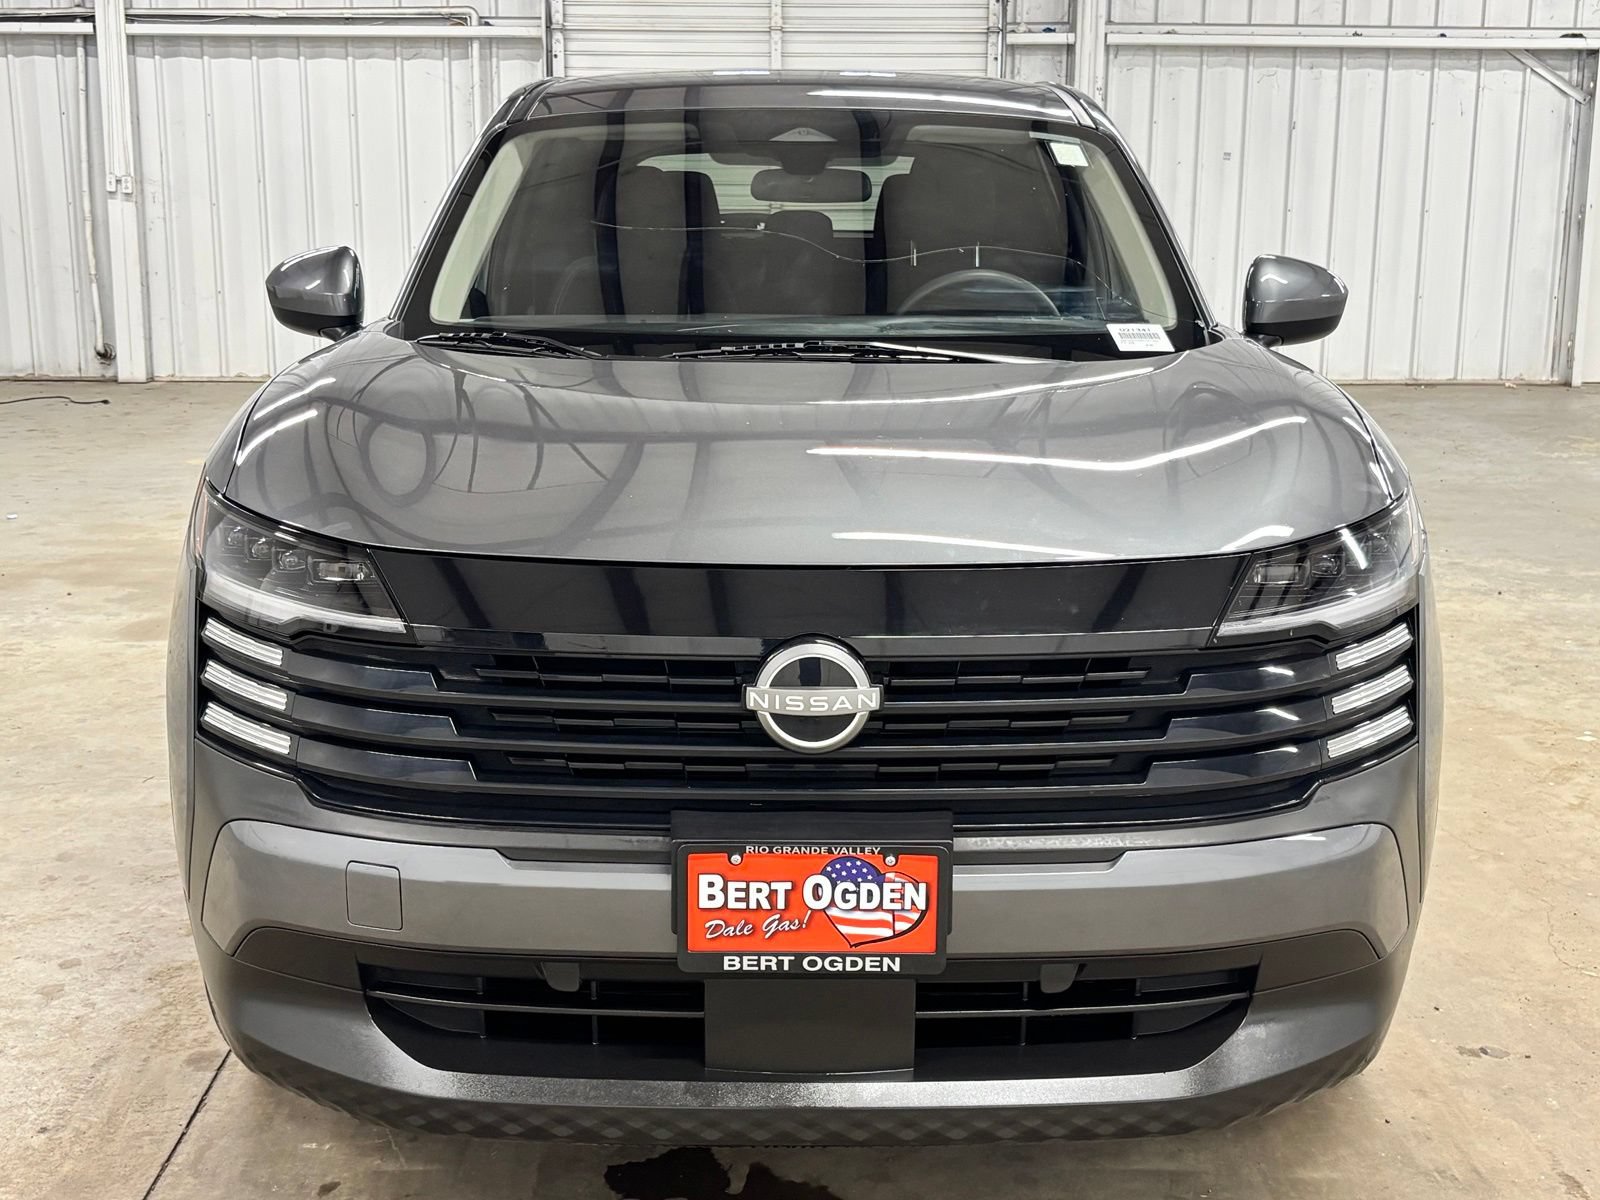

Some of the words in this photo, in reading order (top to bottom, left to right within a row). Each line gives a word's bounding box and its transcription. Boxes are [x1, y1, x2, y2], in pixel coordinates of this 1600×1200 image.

[749, 691, 877, 712] NISSAN
[745, 845, 770, 855] RIO
[775, 845, 829, 856] GRANDE
[831, 846, 881, 856] VALLEY
[697, 873, 793, 911] BERT
[802, 874, 928, 911] OGDEN
[704, 919, 753, 939] Dale
[762, 909, 812, 939] Gas!
[723, 955, 795, 971] BERT
[802, 956, 900, 973] OGDEN
